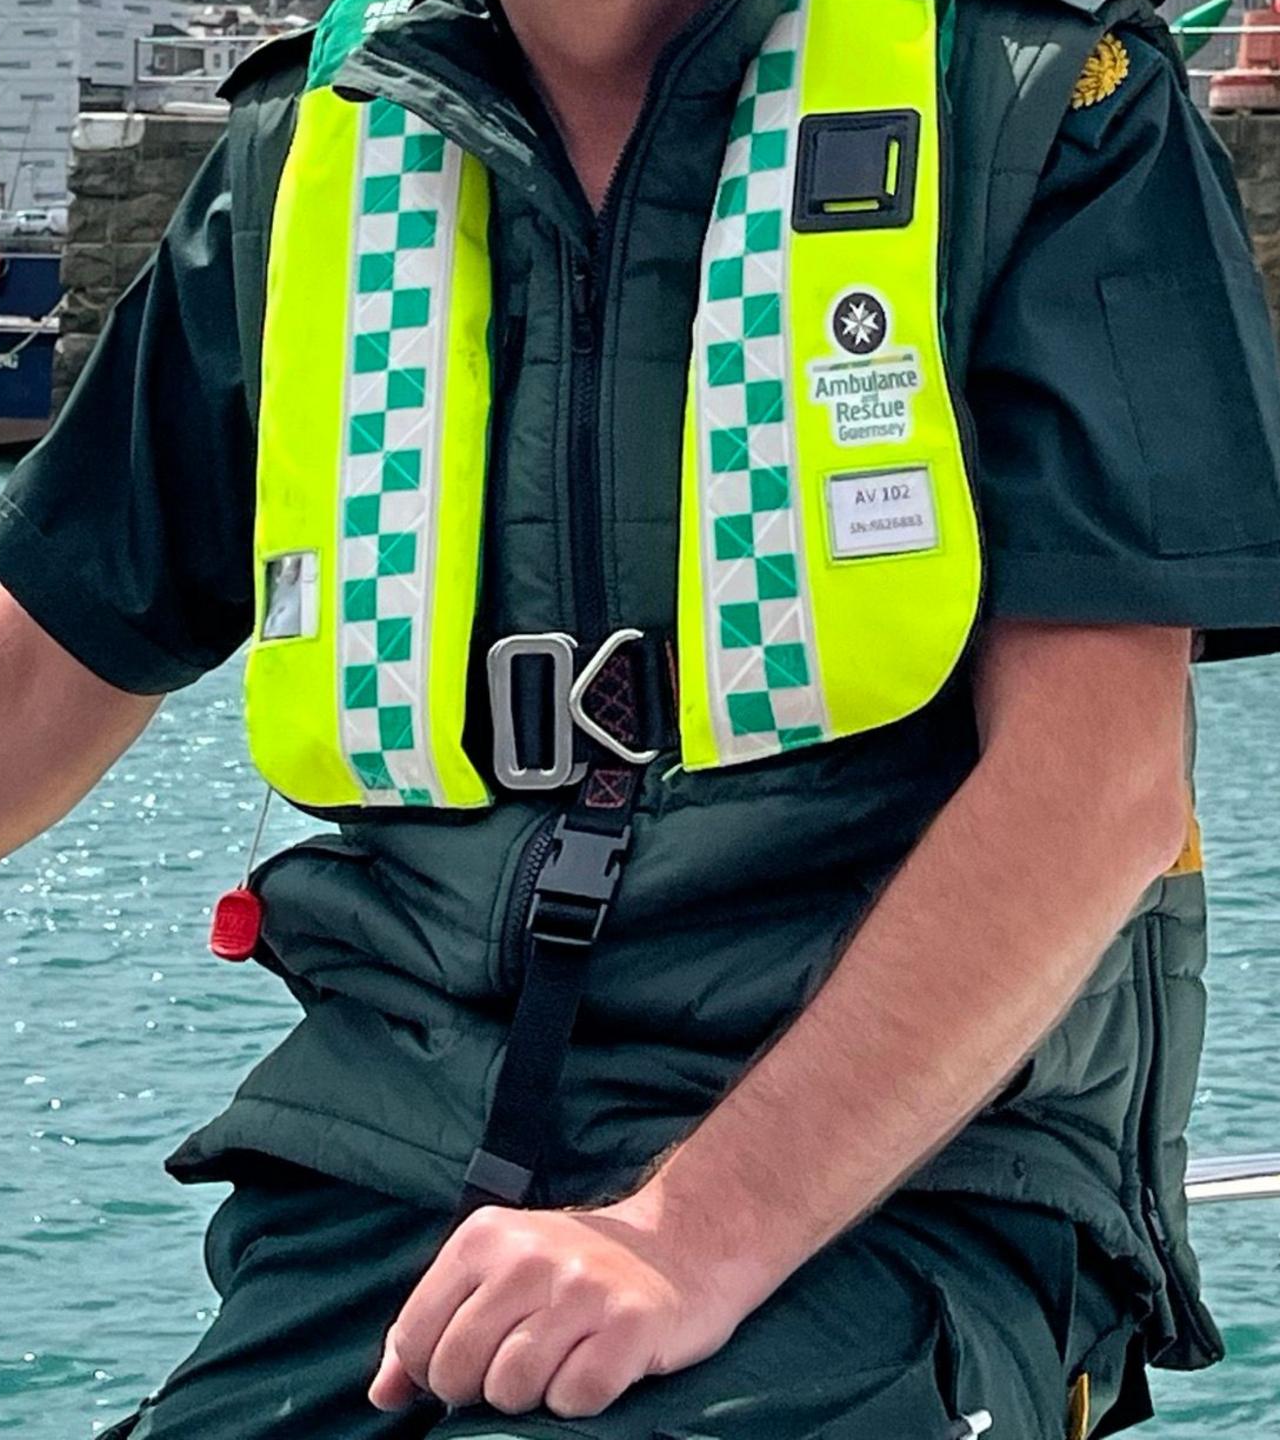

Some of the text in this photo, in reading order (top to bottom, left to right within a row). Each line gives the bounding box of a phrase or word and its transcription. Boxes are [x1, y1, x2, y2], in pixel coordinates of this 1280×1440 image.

[815, 369, 918, 398] Ambulance
[836, 399, 905, 423] Rescue
[838, 423, 905, 441] Guernsey
[854, 483, 911, 506] AV 102
